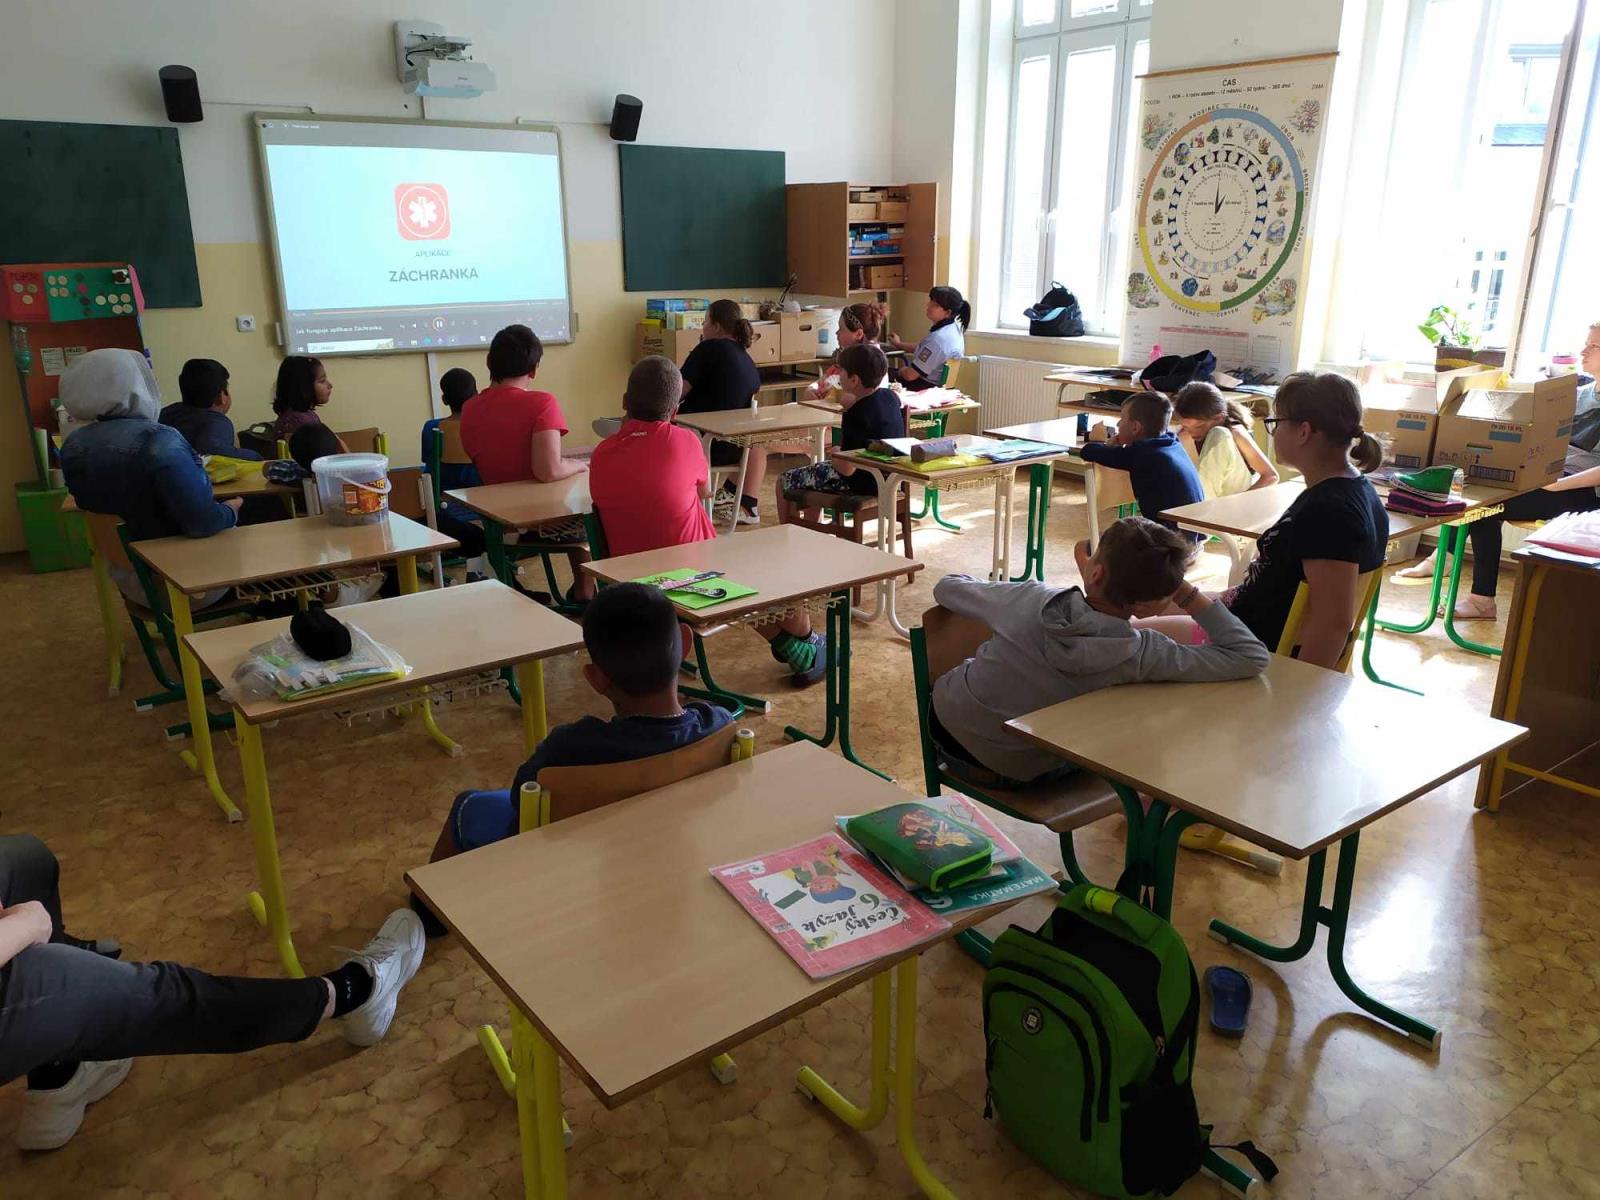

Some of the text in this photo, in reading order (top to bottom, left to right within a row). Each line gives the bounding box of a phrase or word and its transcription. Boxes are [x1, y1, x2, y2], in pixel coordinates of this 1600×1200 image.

[388, 267, 479, 282] ZÁCHRANKA
[967, 875, 1044, 901] MATEMATIKA
[859, 893, 880, 911] 6
[802, 904, 857, 933] jazyk
[845, 907, 899, 935] Český
